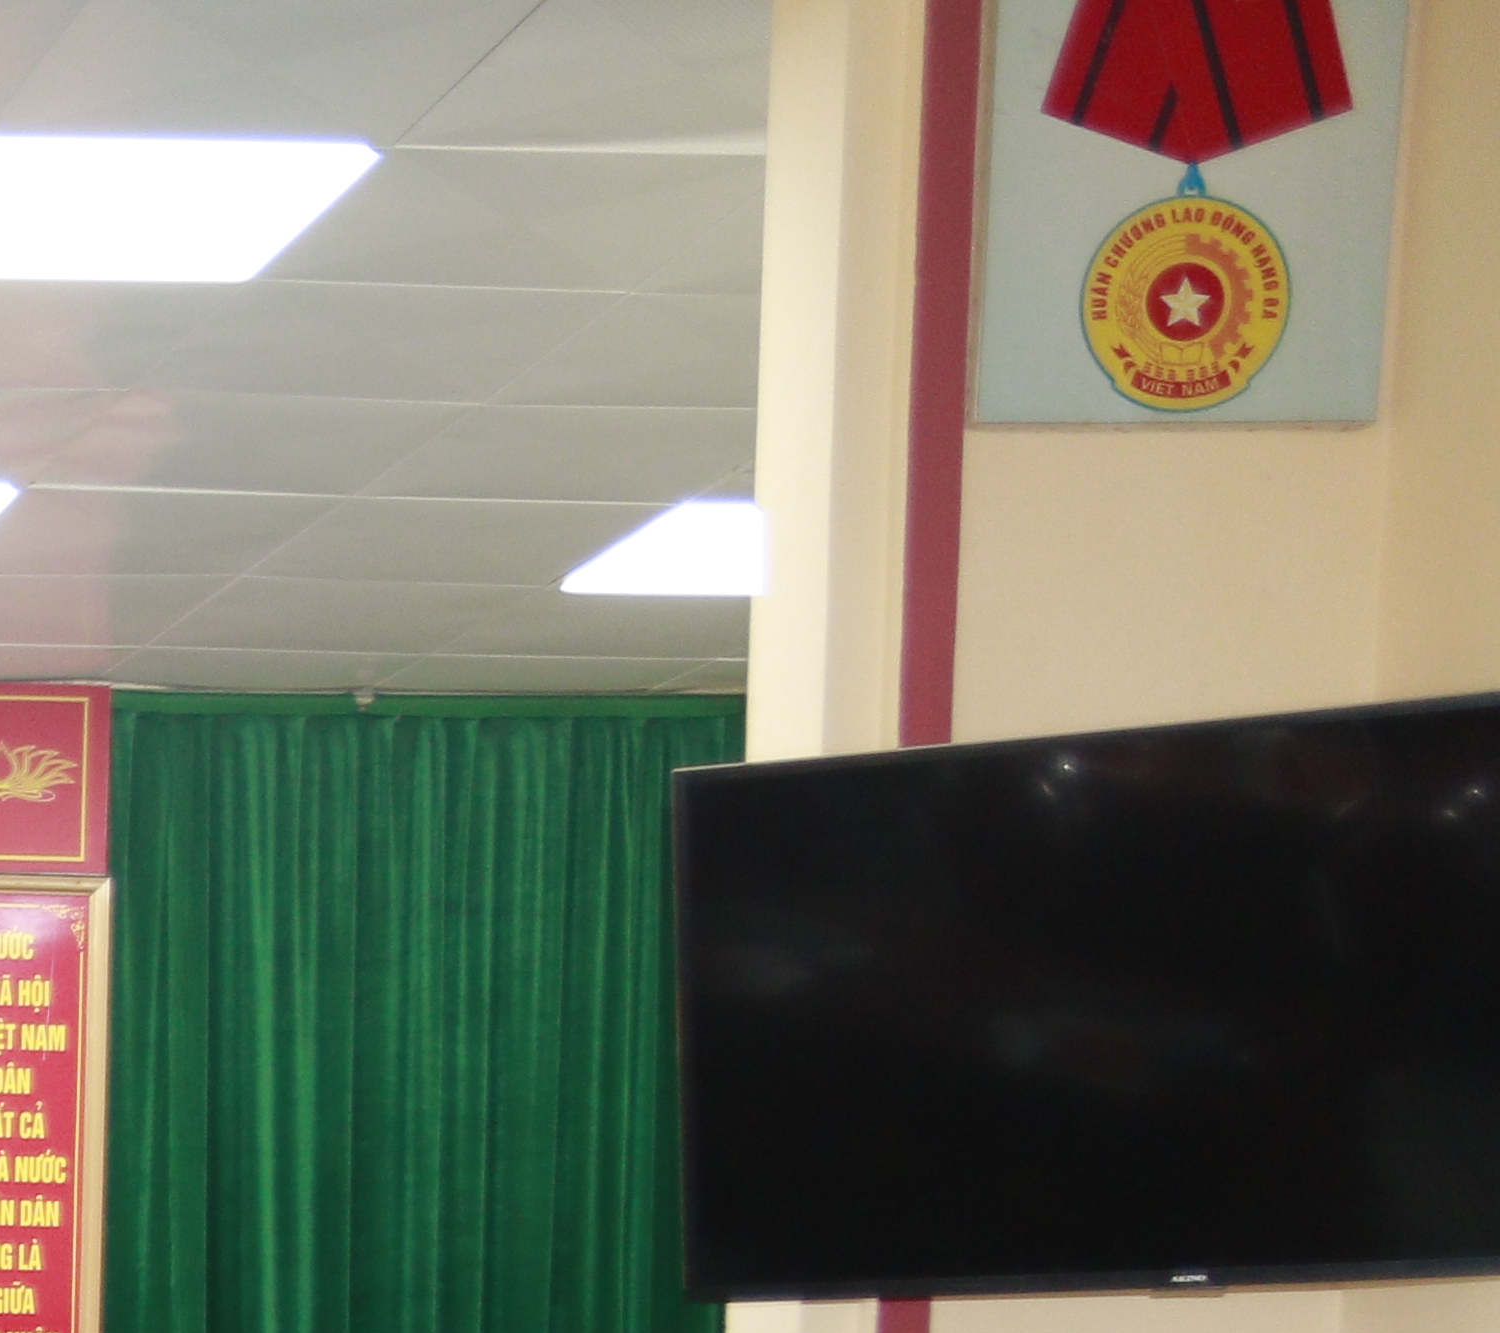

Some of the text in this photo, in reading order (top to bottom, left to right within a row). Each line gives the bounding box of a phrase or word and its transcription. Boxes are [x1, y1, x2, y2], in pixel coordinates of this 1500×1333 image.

[1181, 377, 1219, 396] NAM
[18, 975, 51, 1011] HỘI
[21, 1024, 67, 1051] NAM
[19, 1102, 46, 1139] CẢ
[14, 1150, 68, 1183] NƯỚC
[20, 1195, 61, 1227] DÂN
[18, 1241, 43, 1270] LÀ
